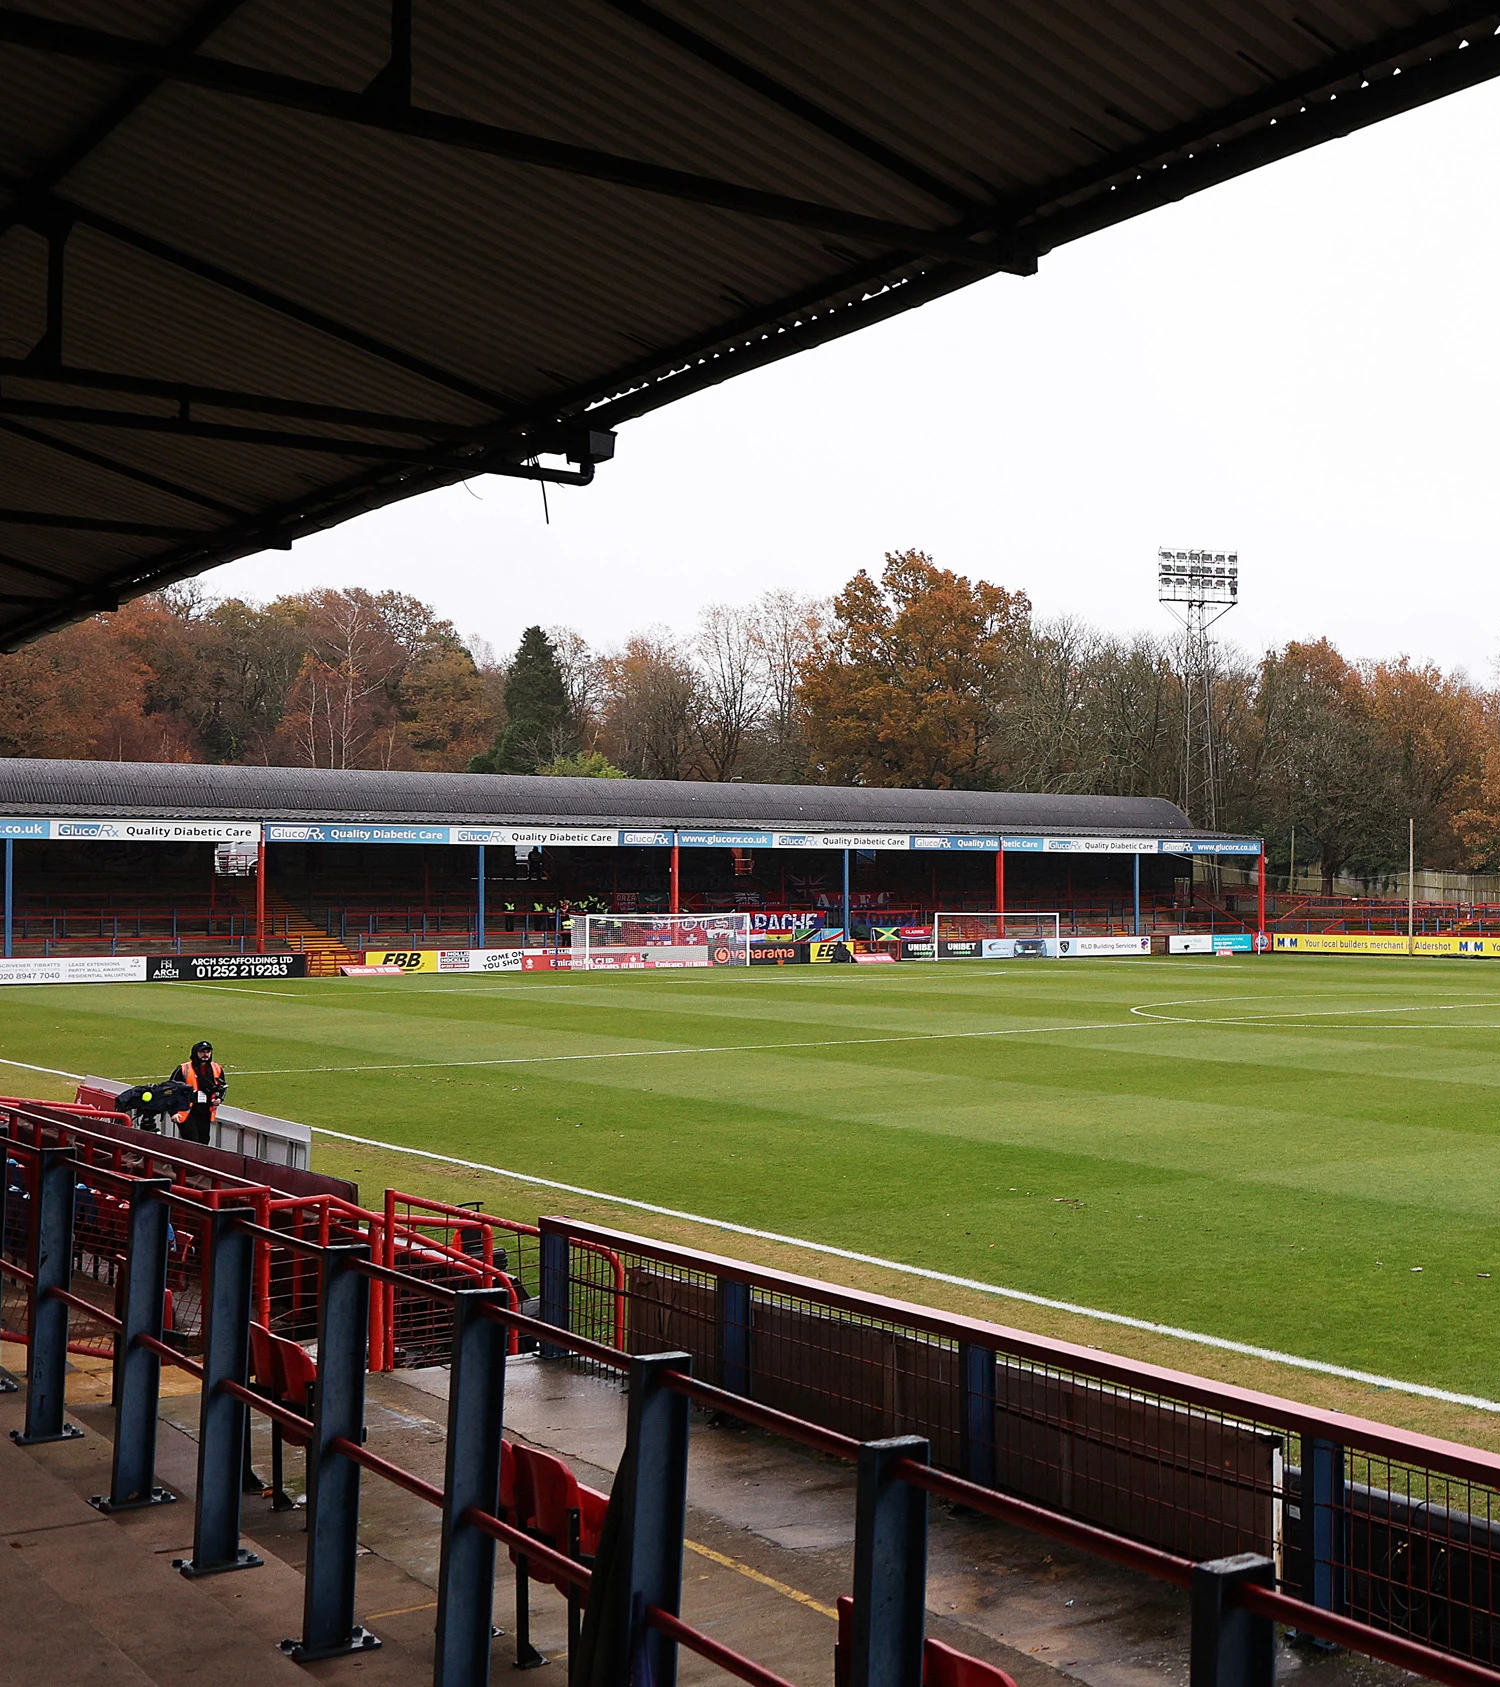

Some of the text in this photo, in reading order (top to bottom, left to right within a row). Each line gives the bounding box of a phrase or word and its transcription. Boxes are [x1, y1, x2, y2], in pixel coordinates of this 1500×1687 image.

[126, 826, 171, 838] Quality
[174, 827, 223, 837] Diabetic
[225, 828, 252, 837] Care
[330, 829, 370, 841] Quality
[372, 829, 419, 840] Diabetic
[420, 831, 443, 840] Care
[511, 832, 547, 843] Quality
[549, 833, 588, 842] Diabetic
[590, 834, 612, 843] Care
[681, 835, 768, 846] www.glucorx.co.uk
[822, 837, 852, 847] Quality
[853, 837, 886, 846] Diabetic
[887, 838, 905, 846] Care
[957, 839, 985, 849] Quality
[1022, 840, 1039, 848] Care
[1084, 842, 1109, 851] Quality
[1110, 842, 1138, 850] Diabetic
[1138, 842, 1154, 850] Care
[1197, 843, 1258, 852] www.glucorx.co.uk
[742, 913, 818, 930] APACHE
[947, 942, 977, 951] UNIBET
[1093, 942, 1114, 951] Building
[1305, 939, 1320, 948] Your
[1321, 939, 1338, 948] local
[1339, 940, 1368, 949] builders
[1369, 940, 1404, 950] merchant
[1414, 941, 1452, 951] Aldershot
[486, 950, 525, 962] COME ON
[730, 948, 795, 959] vanarama
[191, 956, 293, 966] ARCH SCAFFOLDING LTD
[482, 958, 523, 970] YOU SHO
[16, 972, 37, 980] 8947
[153, 968, 179, 976] ARCH
[196, 964, 288, 978] 01252 219283
